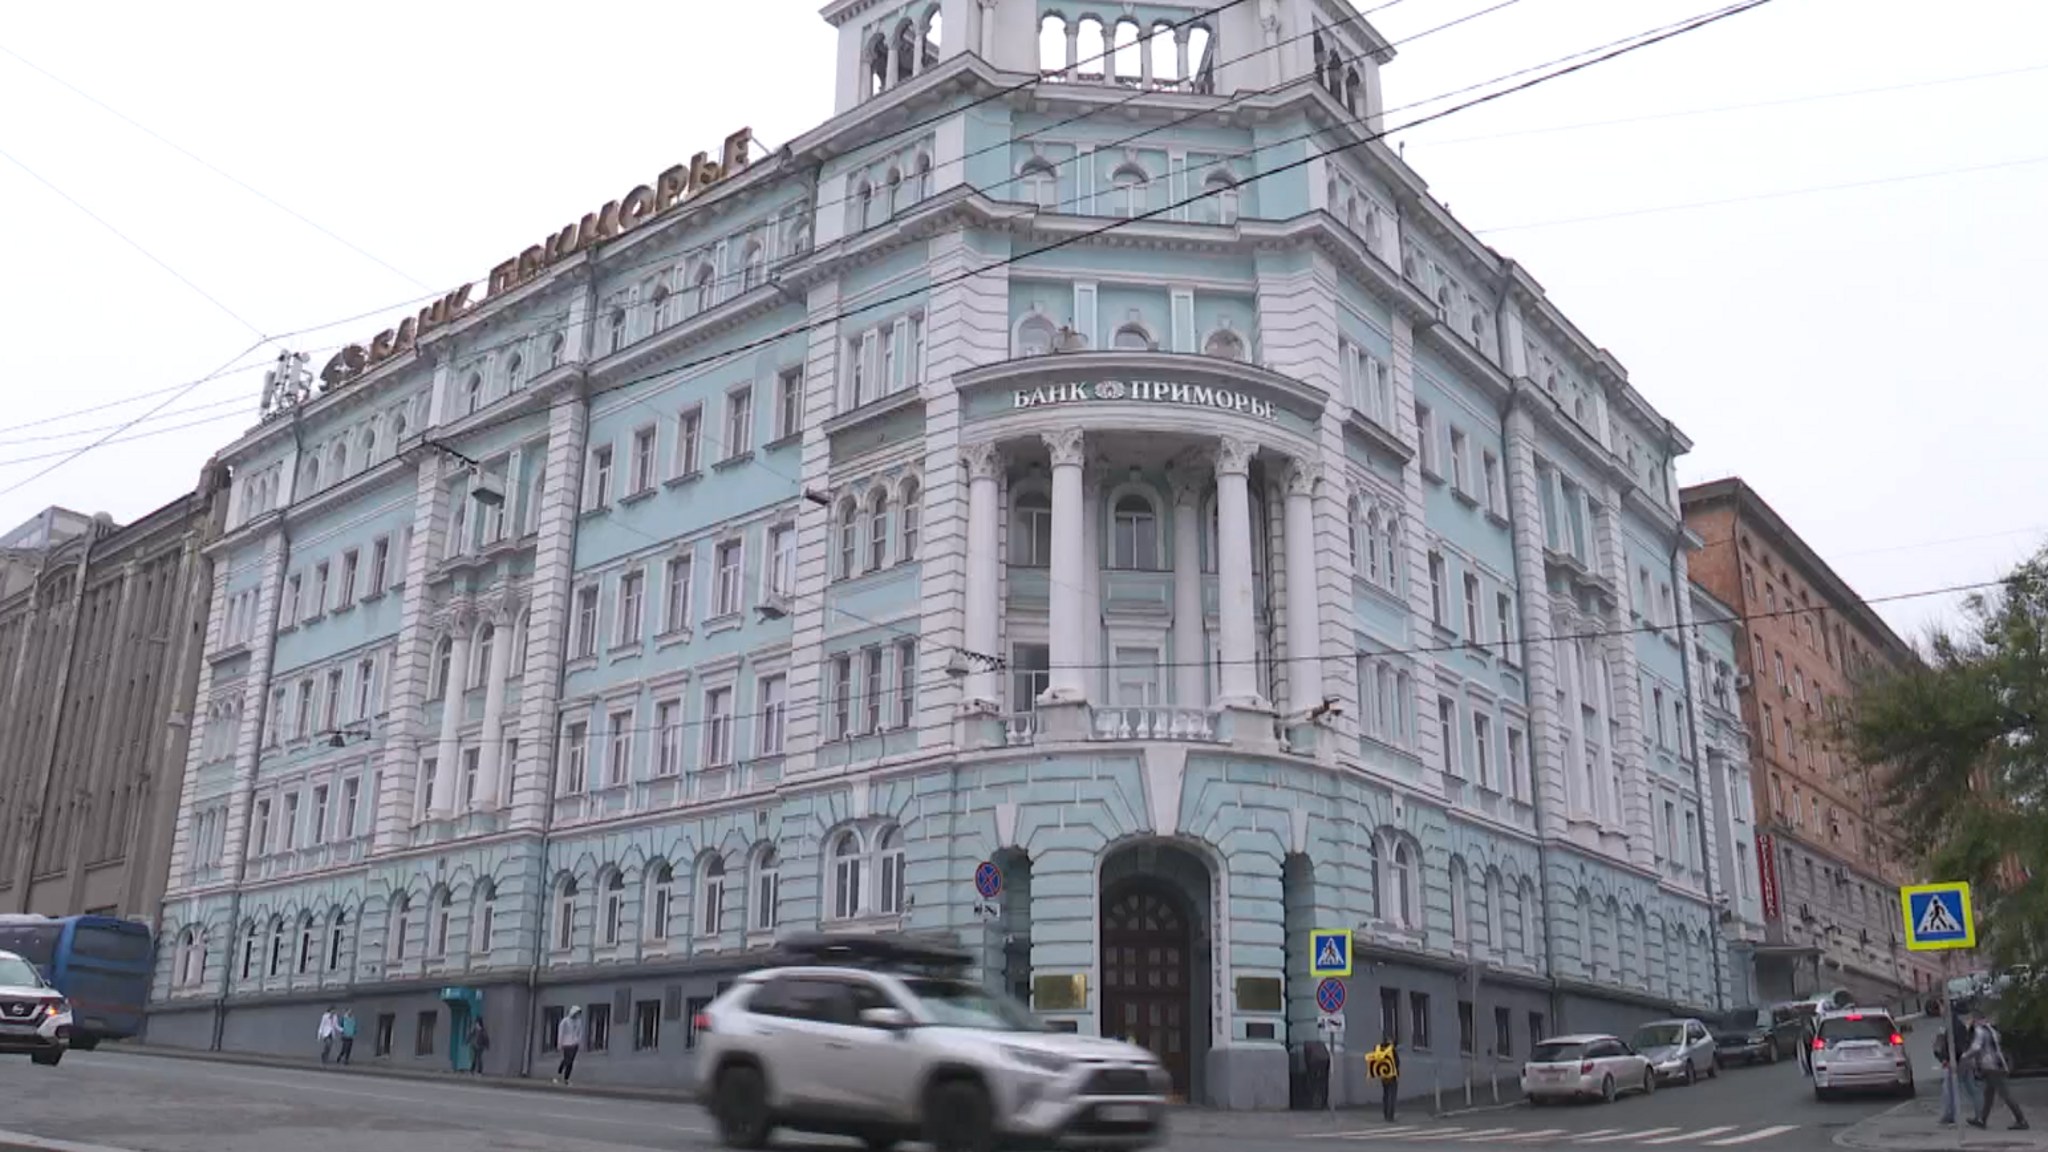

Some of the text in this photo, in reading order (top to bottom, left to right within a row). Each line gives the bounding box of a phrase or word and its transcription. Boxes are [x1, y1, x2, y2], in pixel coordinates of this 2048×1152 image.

[369, 126, 752, 365] БАНК ПРИМОРЬЕ
[1013, 380, 1279, 421] БАНК ПРИМОРЬЕ
